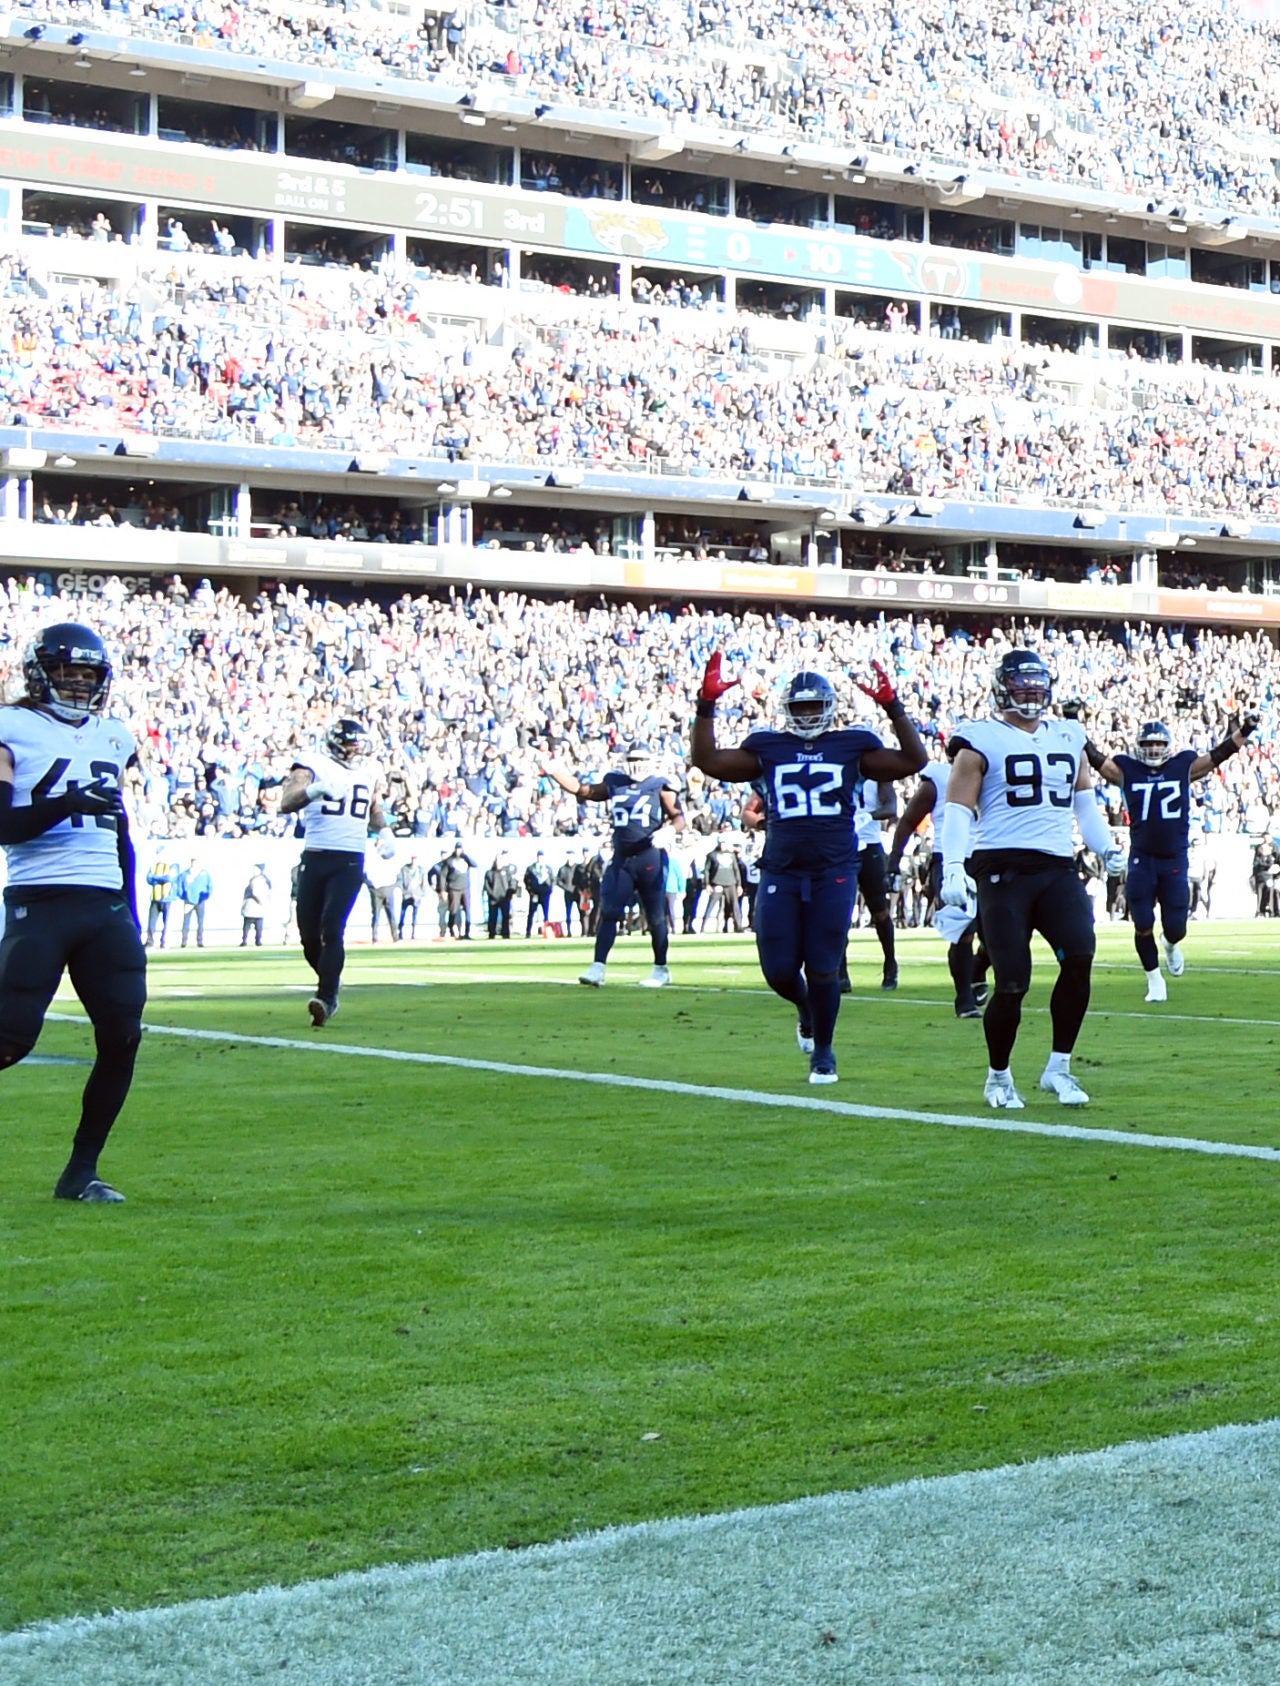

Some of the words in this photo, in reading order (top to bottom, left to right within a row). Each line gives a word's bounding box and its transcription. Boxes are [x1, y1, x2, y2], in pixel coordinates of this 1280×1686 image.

[47, 146, 125, 182] Coke
[133, 165, 197, 190] ZERO
[278, 172, 312, 192] 3rd
[314, 177, 330, 194] &
[332, 179, 346, 196] 5
[275, 193, 306, 208] BALL
[415, 192, 484, 228] 2:51
[504, 207, 545, 234] 3rd
[727, 232, 751, 261] 0
[807, 243, 841, 273] 10
[57, 574, 150, 593] GEOGE
[878, 580, 897, 596] LG
[934, 583, 953, 599] LG
[989, 586, 1008, 601] LG
[773, 763, 846, 819] 62
[1005, 753, 1074, 808] 93
[1131, 780, 1183, 821] 72
